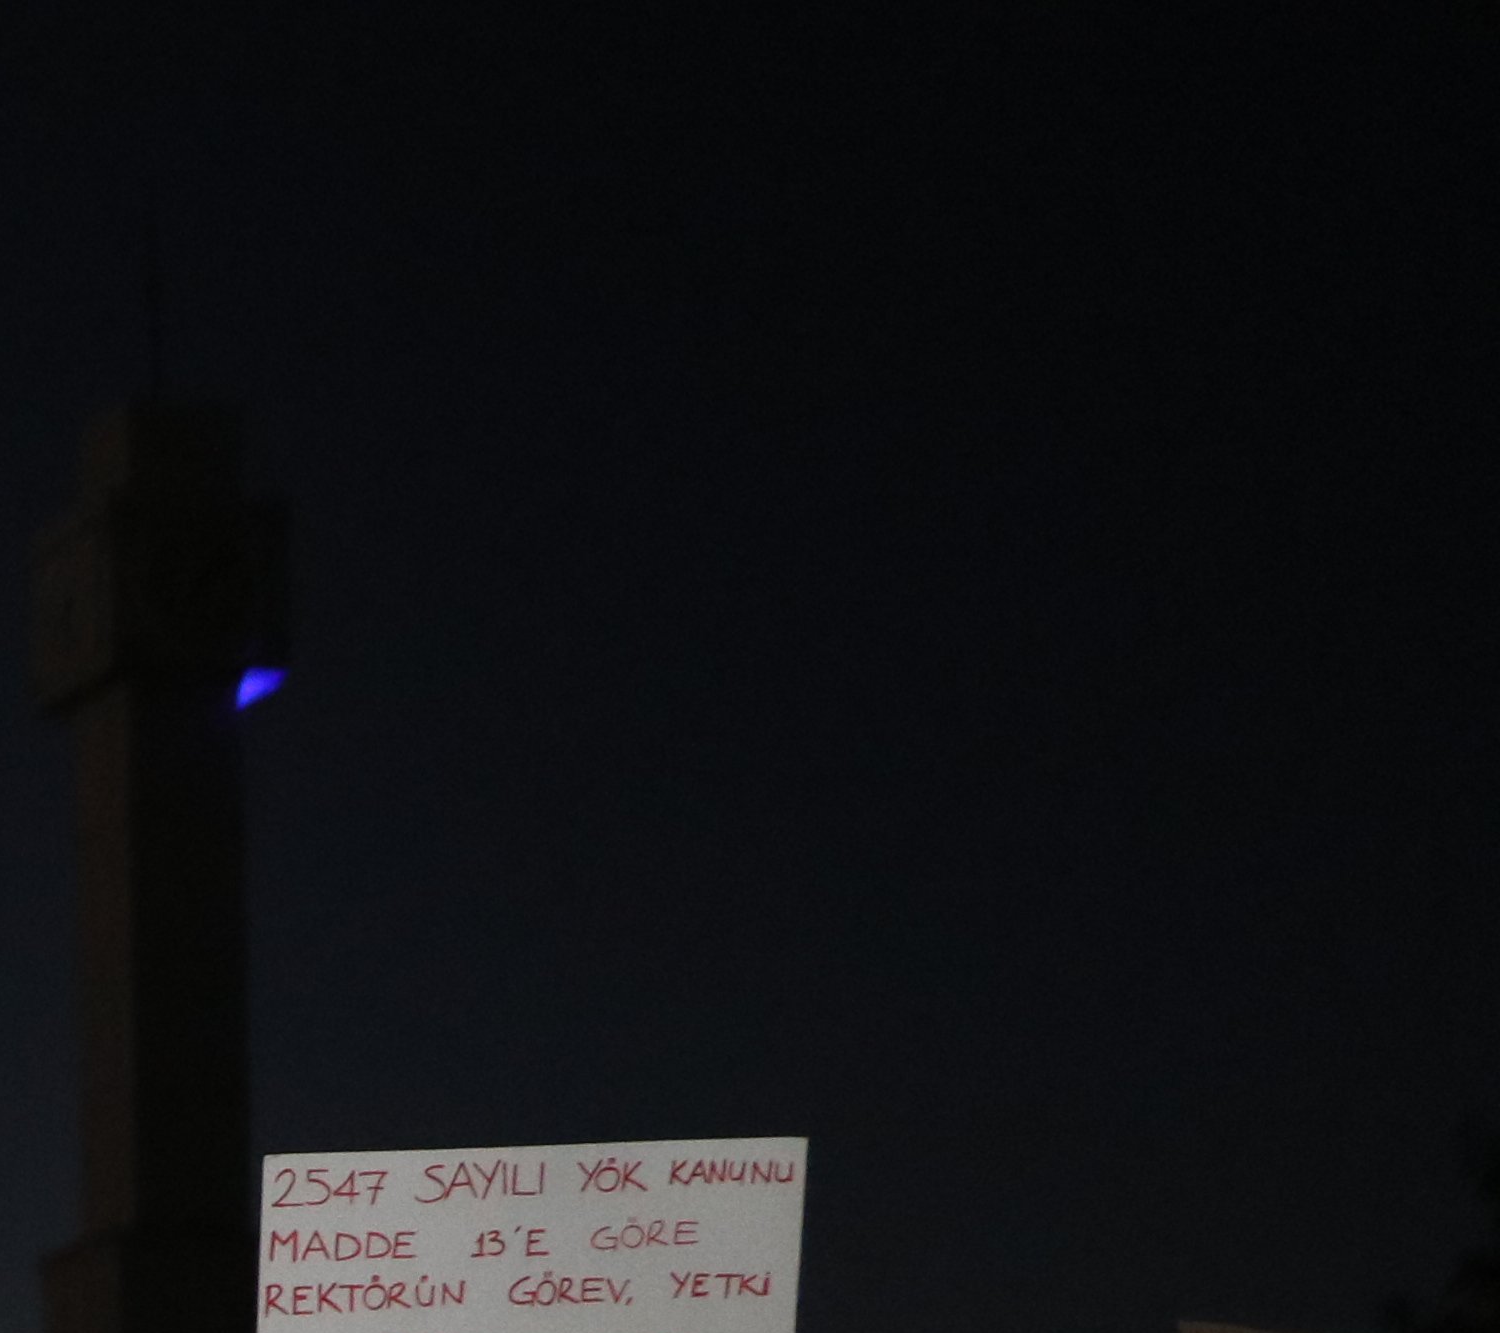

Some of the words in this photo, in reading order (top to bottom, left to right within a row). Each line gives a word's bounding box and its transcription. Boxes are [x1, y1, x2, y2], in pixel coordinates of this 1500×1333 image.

[270, 1167, 389, 1208] 2547
[414, 1159, 546, 1204] SAYILI
[577, 1156, 649, 1194] YÖK
[668, 1157, 797, 1187] KANUNU
[268, 1228, 418, 1264] MADDE
[589, 1215, 700, 1251] GÖRE
[263, 1274, 467, 1319] REKTÖRÜN
[507, 1270, 635, 1307] GÖREV,
[669, 1270, 773, 1300] YETKİ
